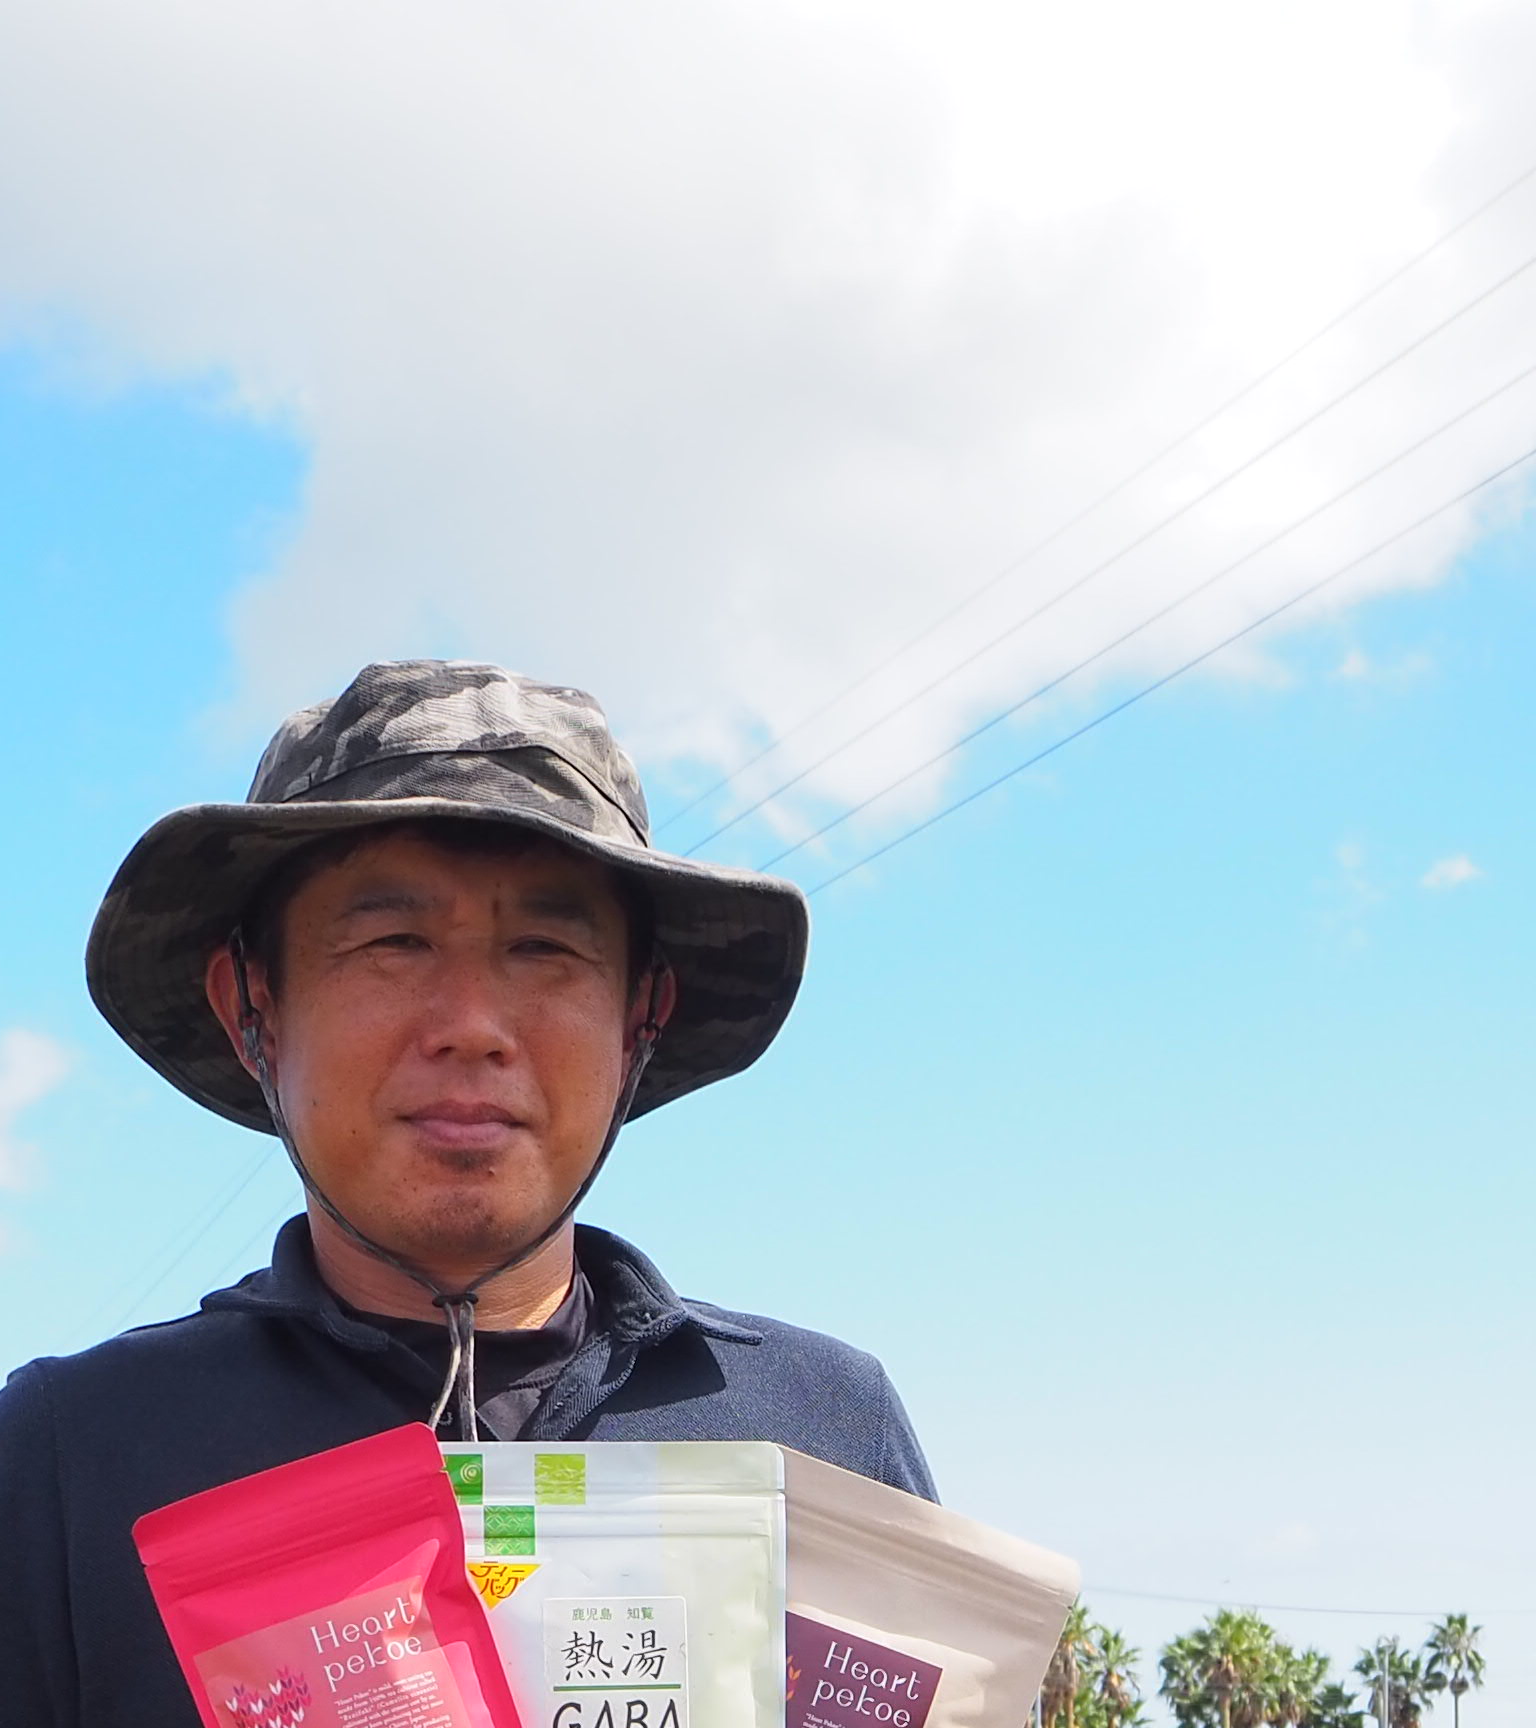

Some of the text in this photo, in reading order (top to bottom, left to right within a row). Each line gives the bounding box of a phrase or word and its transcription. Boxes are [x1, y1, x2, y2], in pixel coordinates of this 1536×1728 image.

[480, 1577, 525, 1599] バッグ
[572, 1607, 654, 1621] 鹿児島 知覧
[310, 1597, 415, 1654] Heart
[324, 1636, 421, 1693] pekoe
[561, 1629, 668, 1681] 熱湯
[824, 1641, 920, 1700] Heart
[811, 1680, 910, 1728] pekoe
